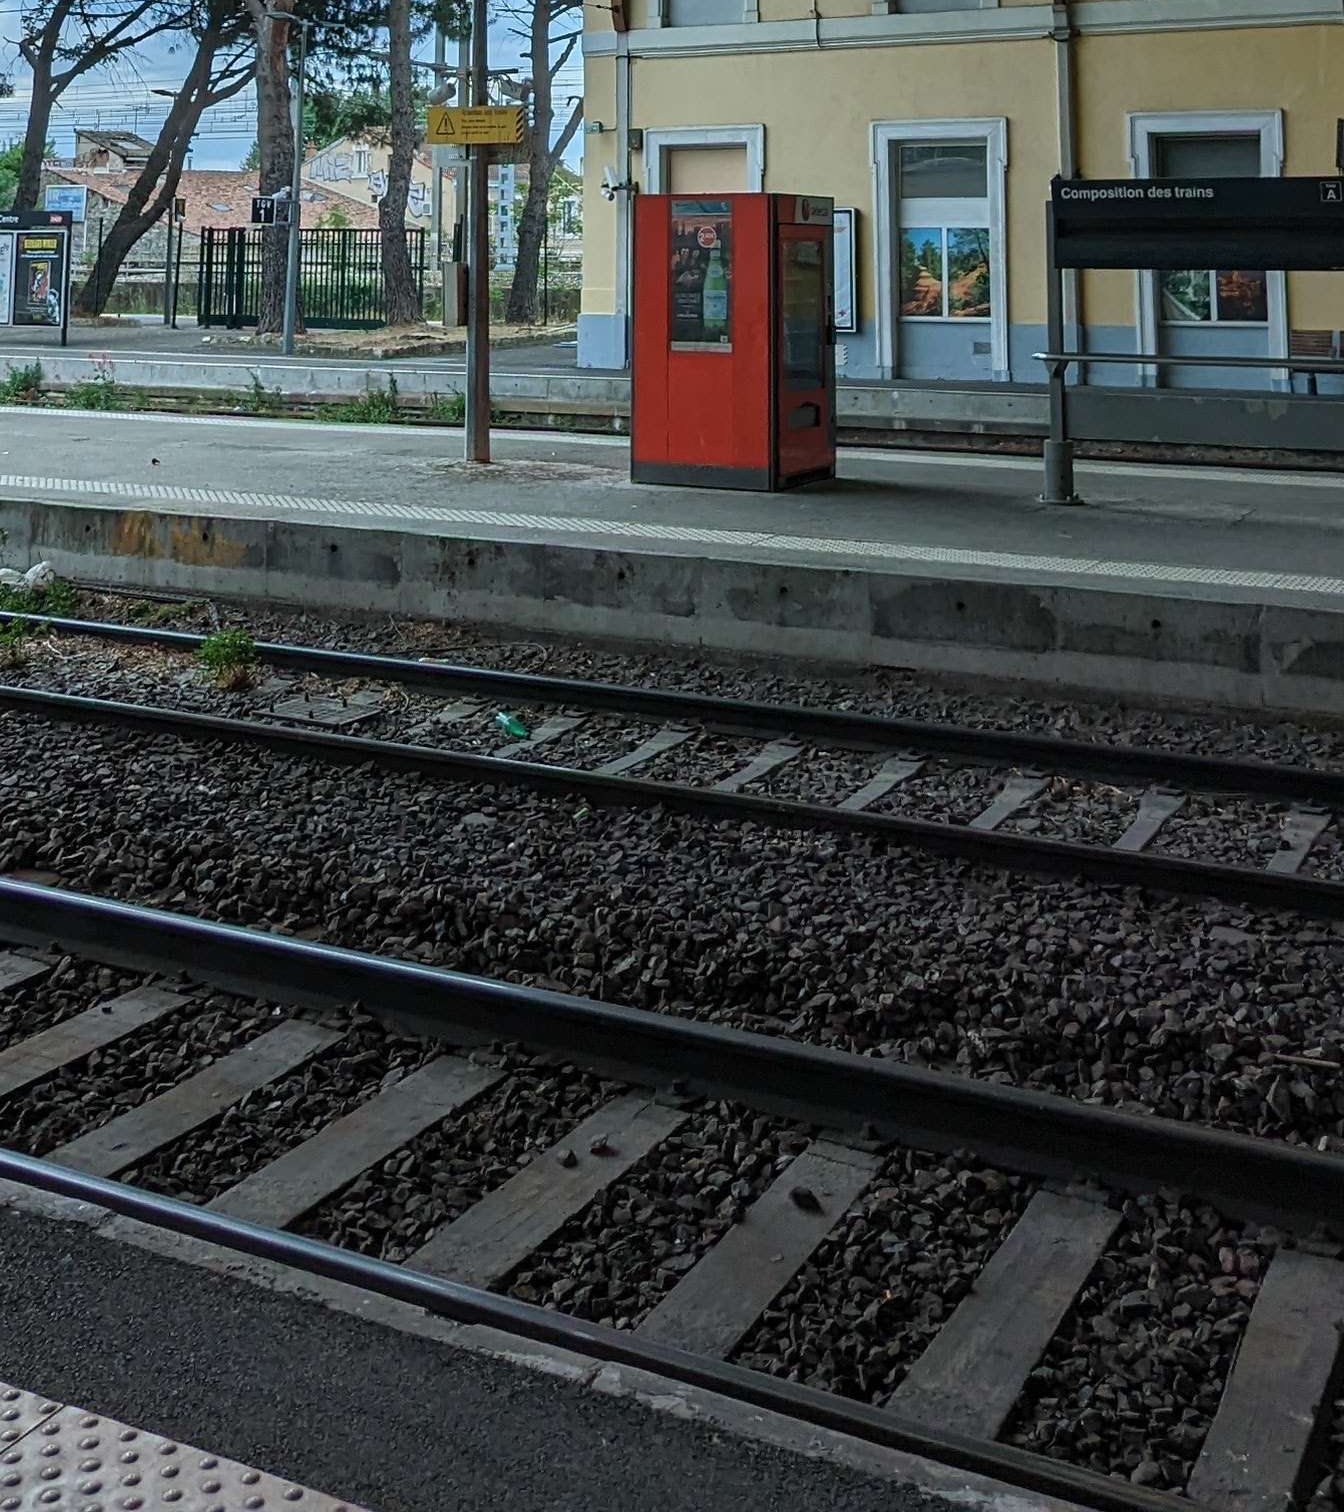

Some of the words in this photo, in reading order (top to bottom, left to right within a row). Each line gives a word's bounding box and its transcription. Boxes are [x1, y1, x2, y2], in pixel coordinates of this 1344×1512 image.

[1060, 187, 1144, 201] Composition
[1147, 186, 1172, 198] des
[1174, 186, 1214, 198] trains
[1327, 189, 1336, 200] A
[256, 199, 272, 209] TGV
[259, 209, 265, 222] 1
